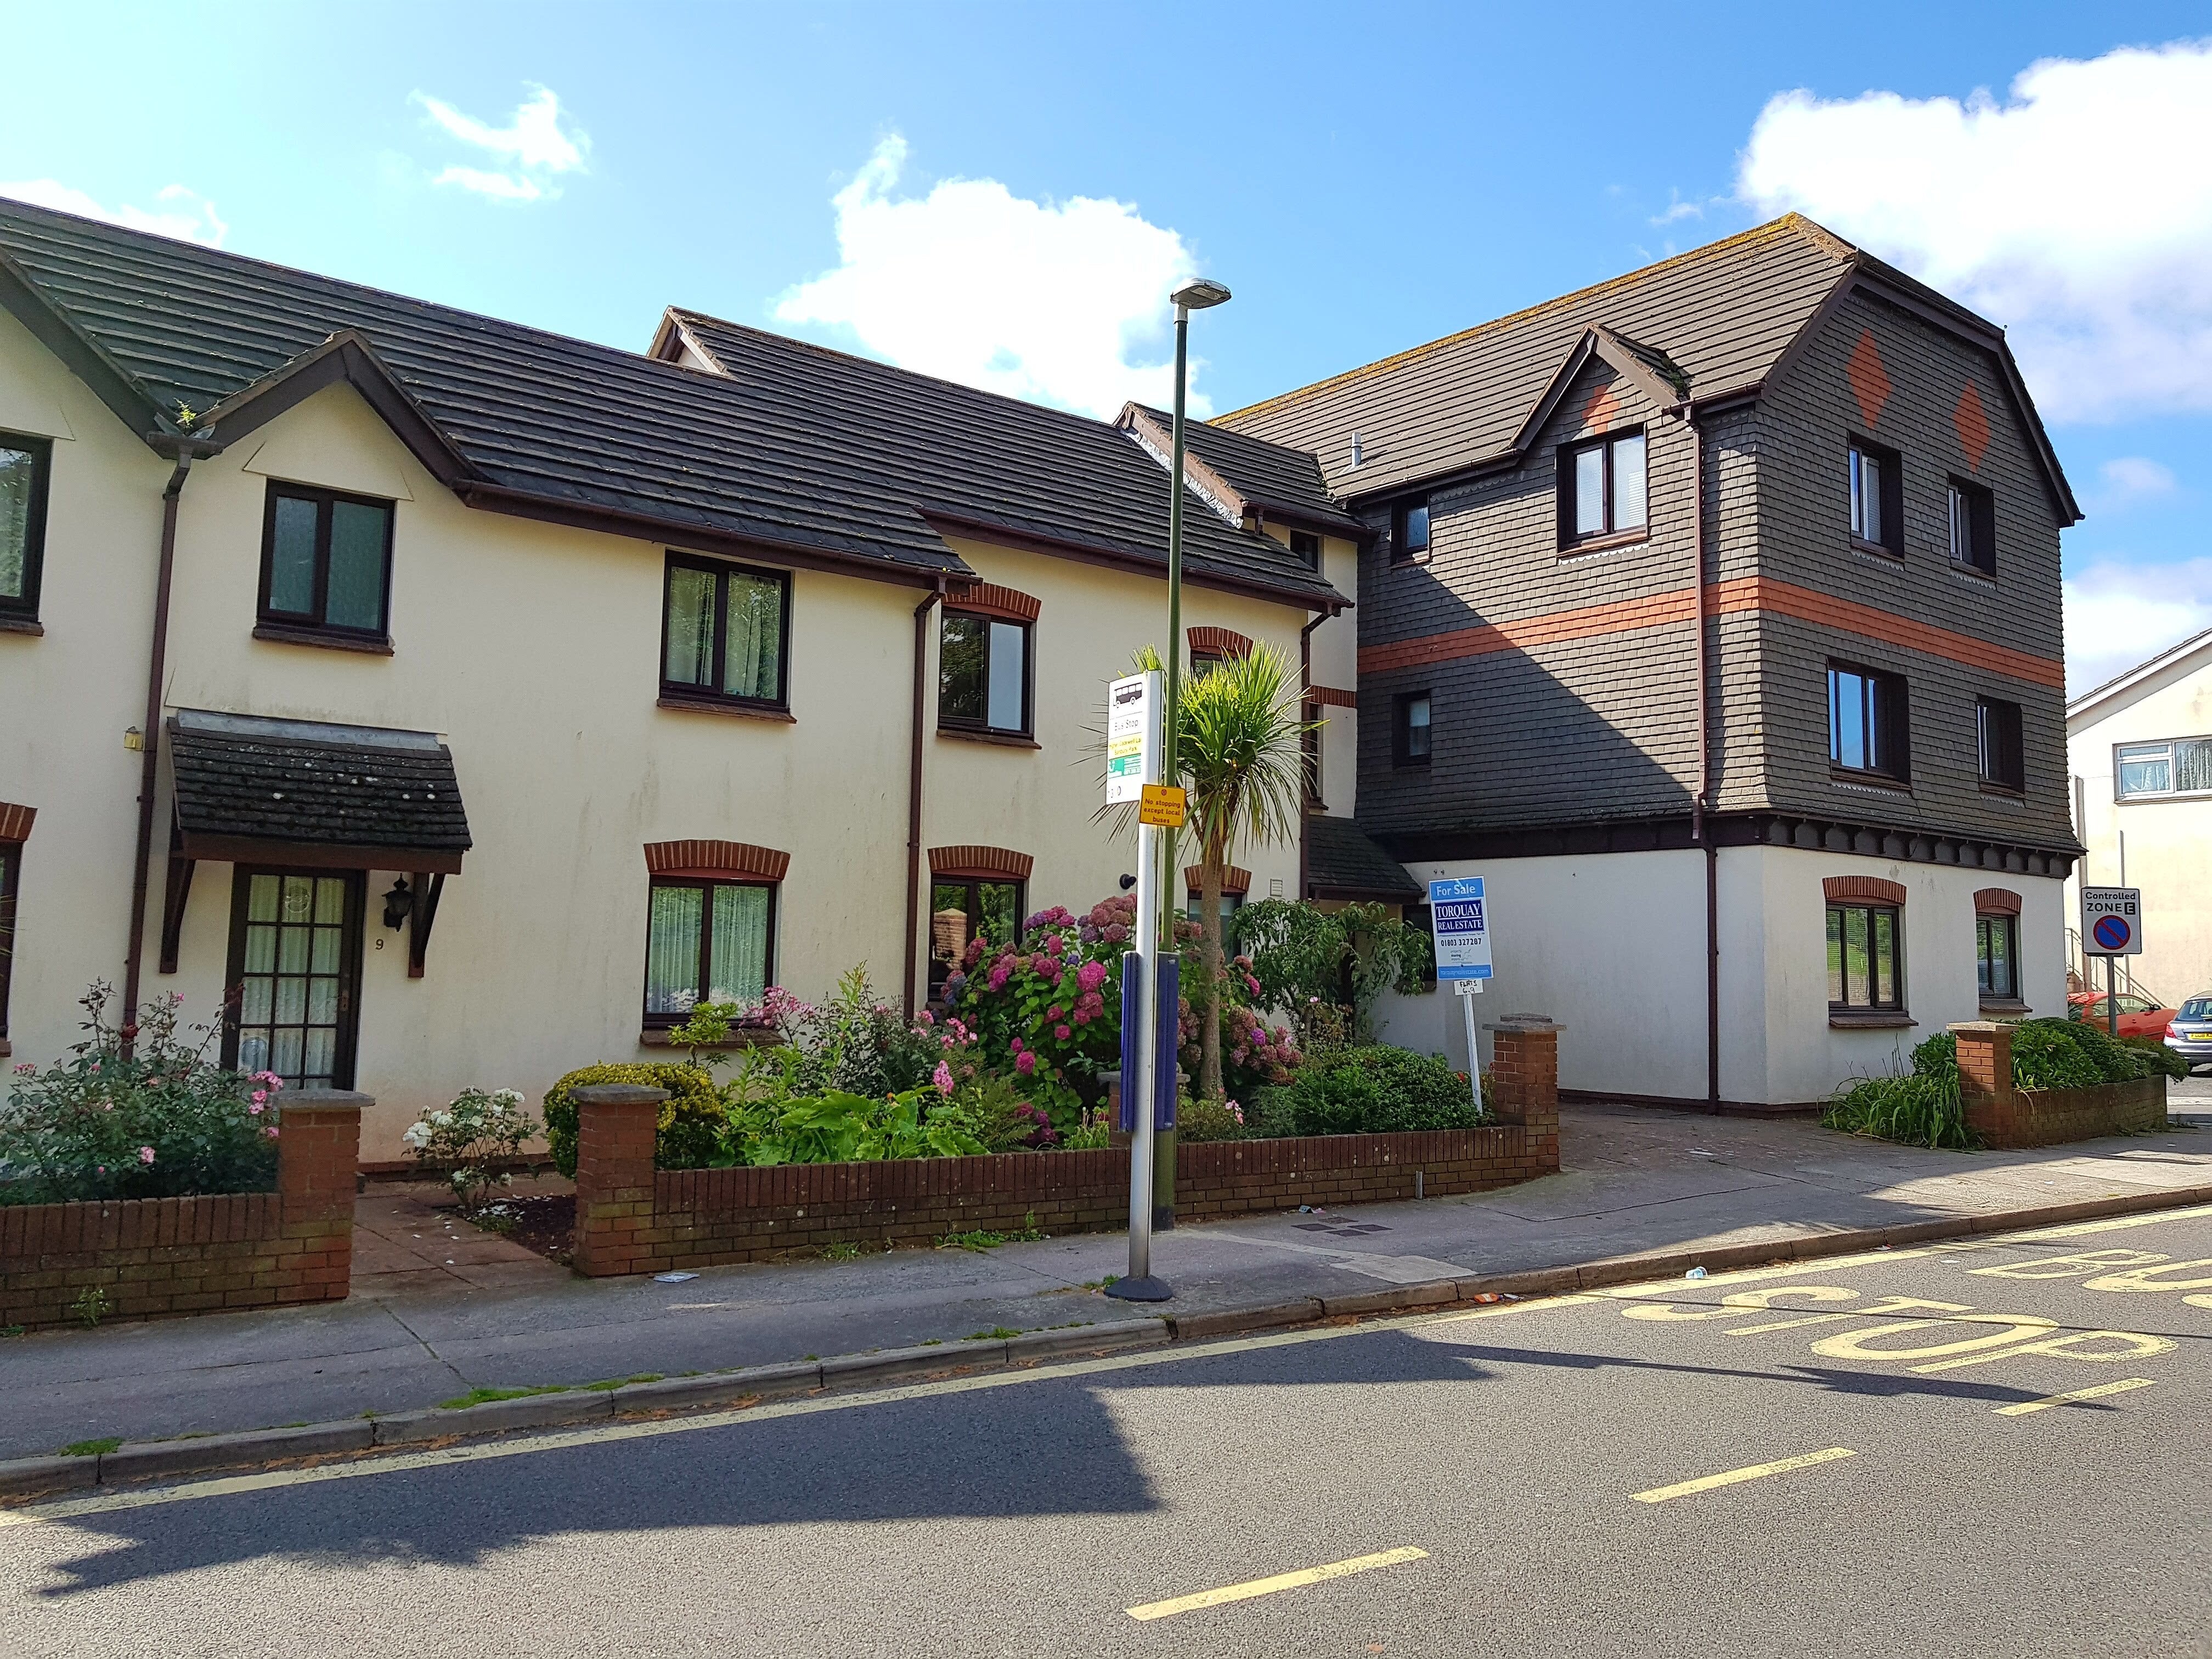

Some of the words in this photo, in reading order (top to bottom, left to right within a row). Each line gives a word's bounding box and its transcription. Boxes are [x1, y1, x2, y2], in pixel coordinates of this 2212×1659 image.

[1125, 719, 1138, 729] Stop
[1156, 800, 1181, 809] stopping
[1436, 885, 1452, 896] For
[1453, 883, 1476, 895] Sale
[1436, 903, 1480, 919] TORQUAY
[2086, 902, 2122, 912] ZONE
[2126, 903, 2135, 914] E
[1437, 921, 1454, 930] REAL
[1455, 919, 1482, 929] ESTATE
[376, 939, 383, 950] 9
[1459, 938, 1482, 946] 327287
[1963, 1249, 2212, 1309] BU
[1620, 1286, 2179, 1374] STOP
